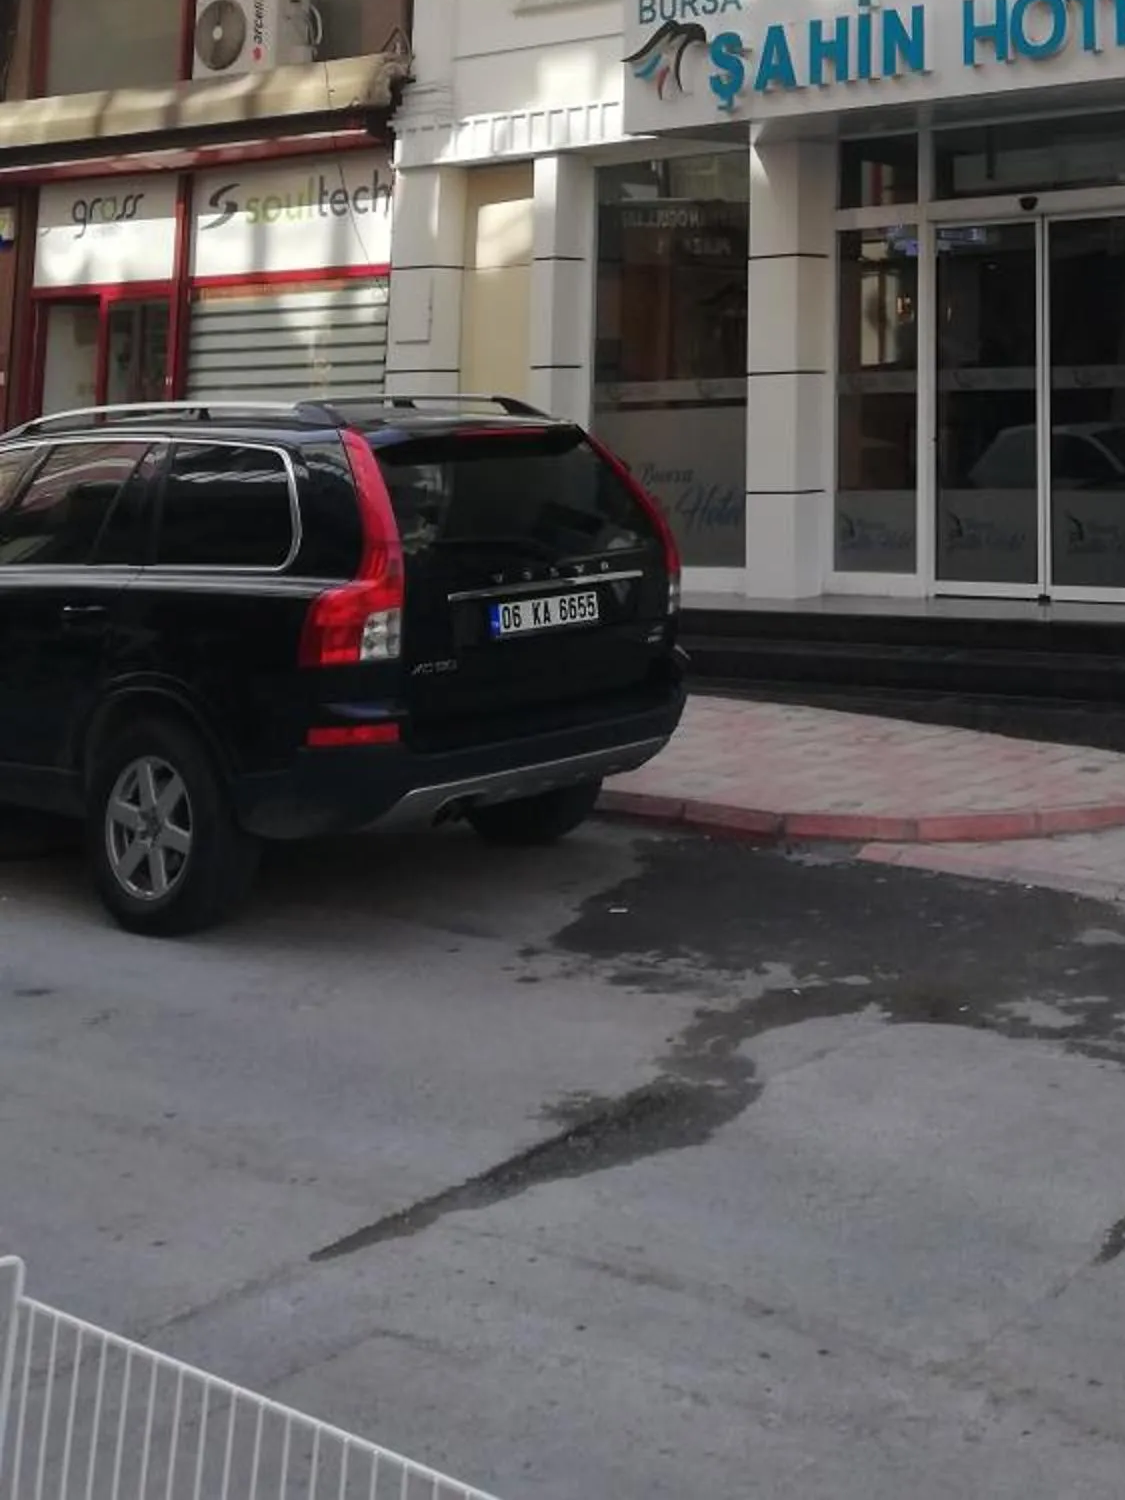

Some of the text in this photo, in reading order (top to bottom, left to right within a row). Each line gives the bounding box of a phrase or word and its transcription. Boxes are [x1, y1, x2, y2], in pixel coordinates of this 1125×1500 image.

[245, 169, 392, 224] soultech
[501, 594, 596, 630] 06 KA 6655
